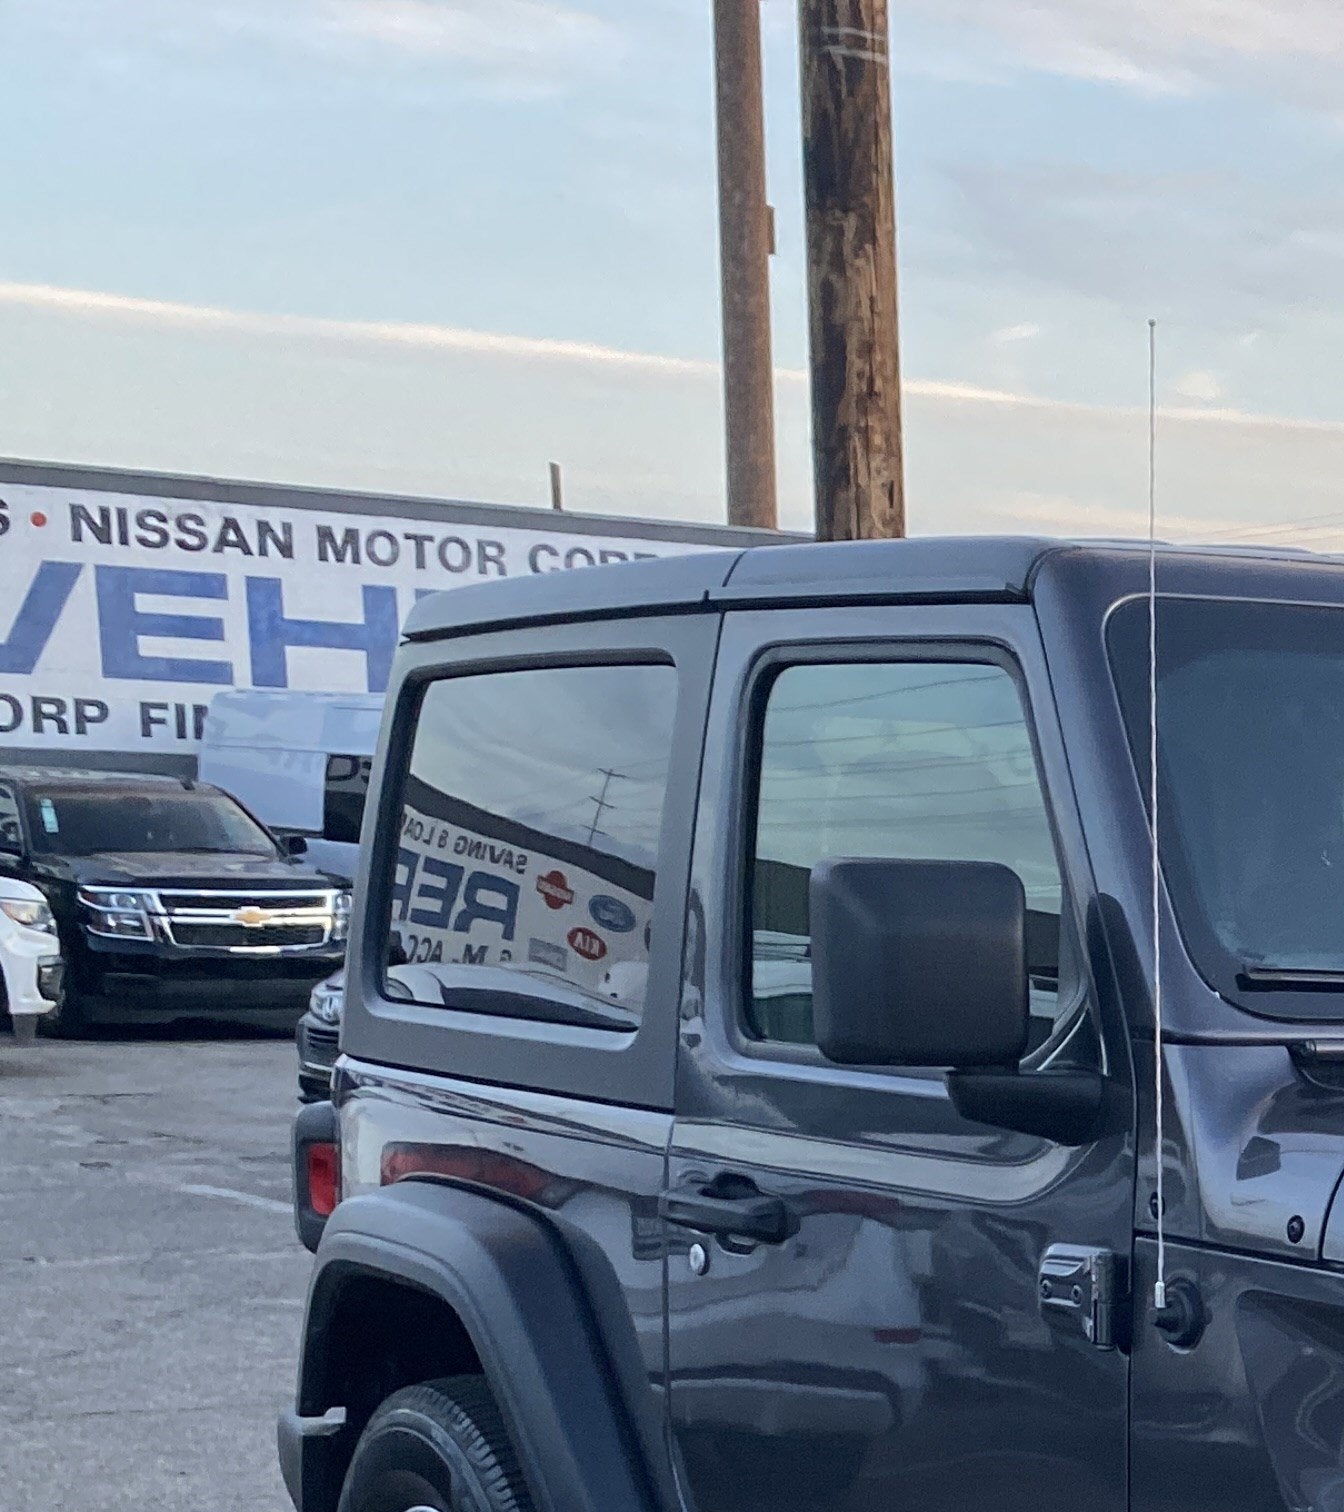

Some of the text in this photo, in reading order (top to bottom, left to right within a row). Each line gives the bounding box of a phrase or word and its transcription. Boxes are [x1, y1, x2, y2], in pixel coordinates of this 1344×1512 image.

[68, 502, 294, 560] NISSAN
[315, 524, 508, 577] MOTOR
[528, 543, 661, 575] CO
